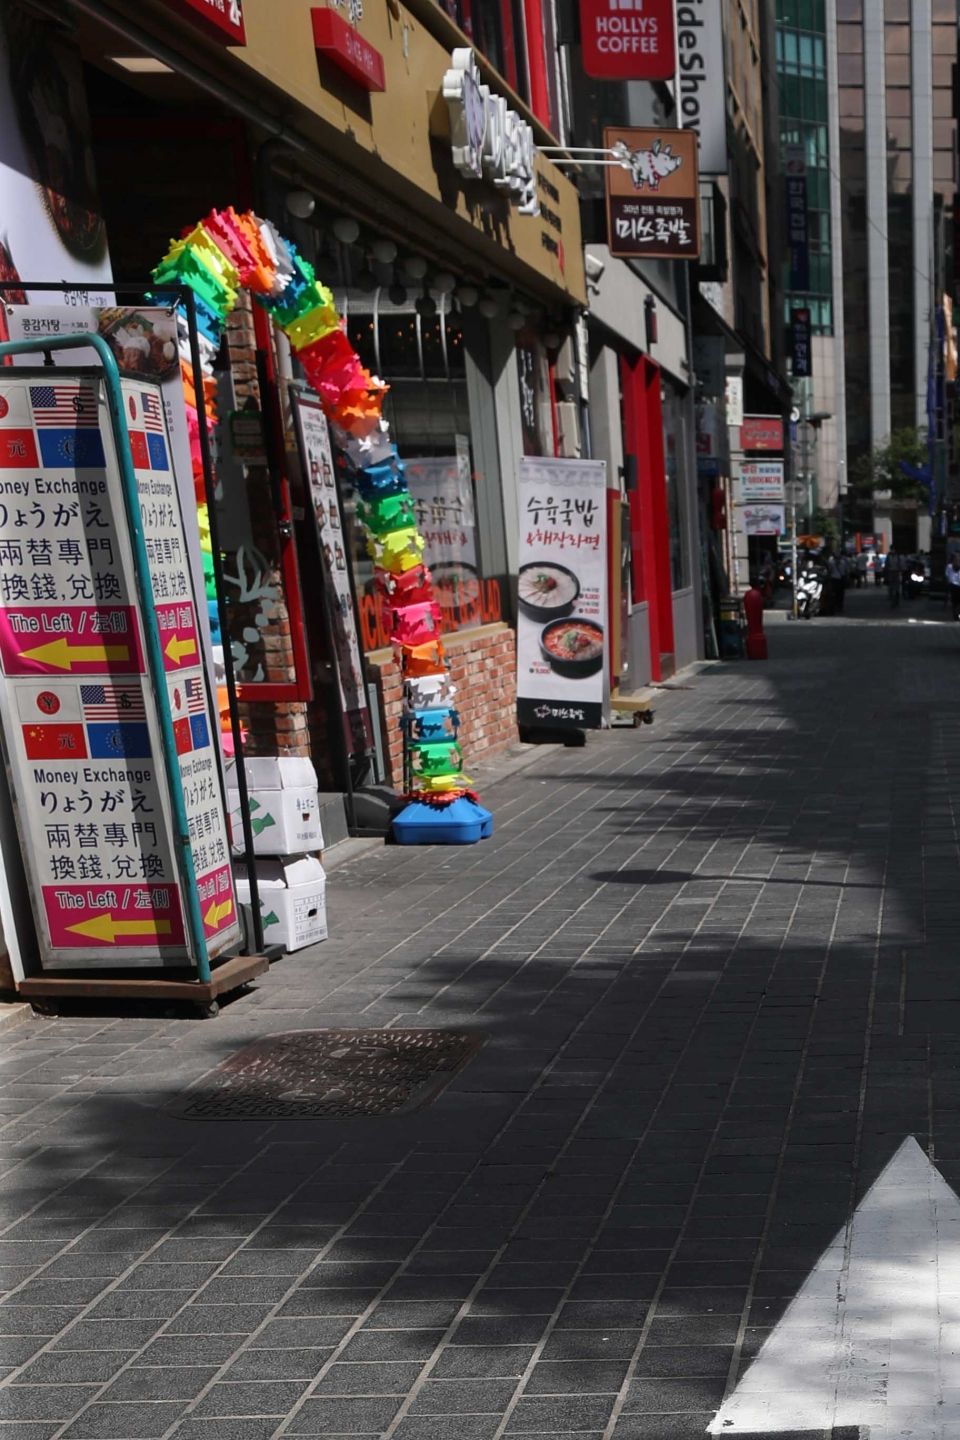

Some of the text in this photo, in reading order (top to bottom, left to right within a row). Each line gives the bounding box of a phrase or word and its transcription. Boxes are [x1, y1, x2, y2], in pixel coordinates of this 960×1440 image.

[595, 16, 658, 33] HOLLYS
[596, 36, 658, 54] COFFEE
[615, 216, 692, 245] 미쓰족발
[36, 478, 106, 496] Exchange
[527, 496, 598, 526] 수육국밥
[8, 614, 39, 632] The
[41, 612, 73, 632] Left
[91, 611, 128, 633] 左側
[34, 767, 151, 784] Money Exchange
[40, 789, 154, 814] りょうがえ
[56, 891, 85, 908] The
[86, 890, 116, 908] Left
[134, 888, 169, 909] 左側
